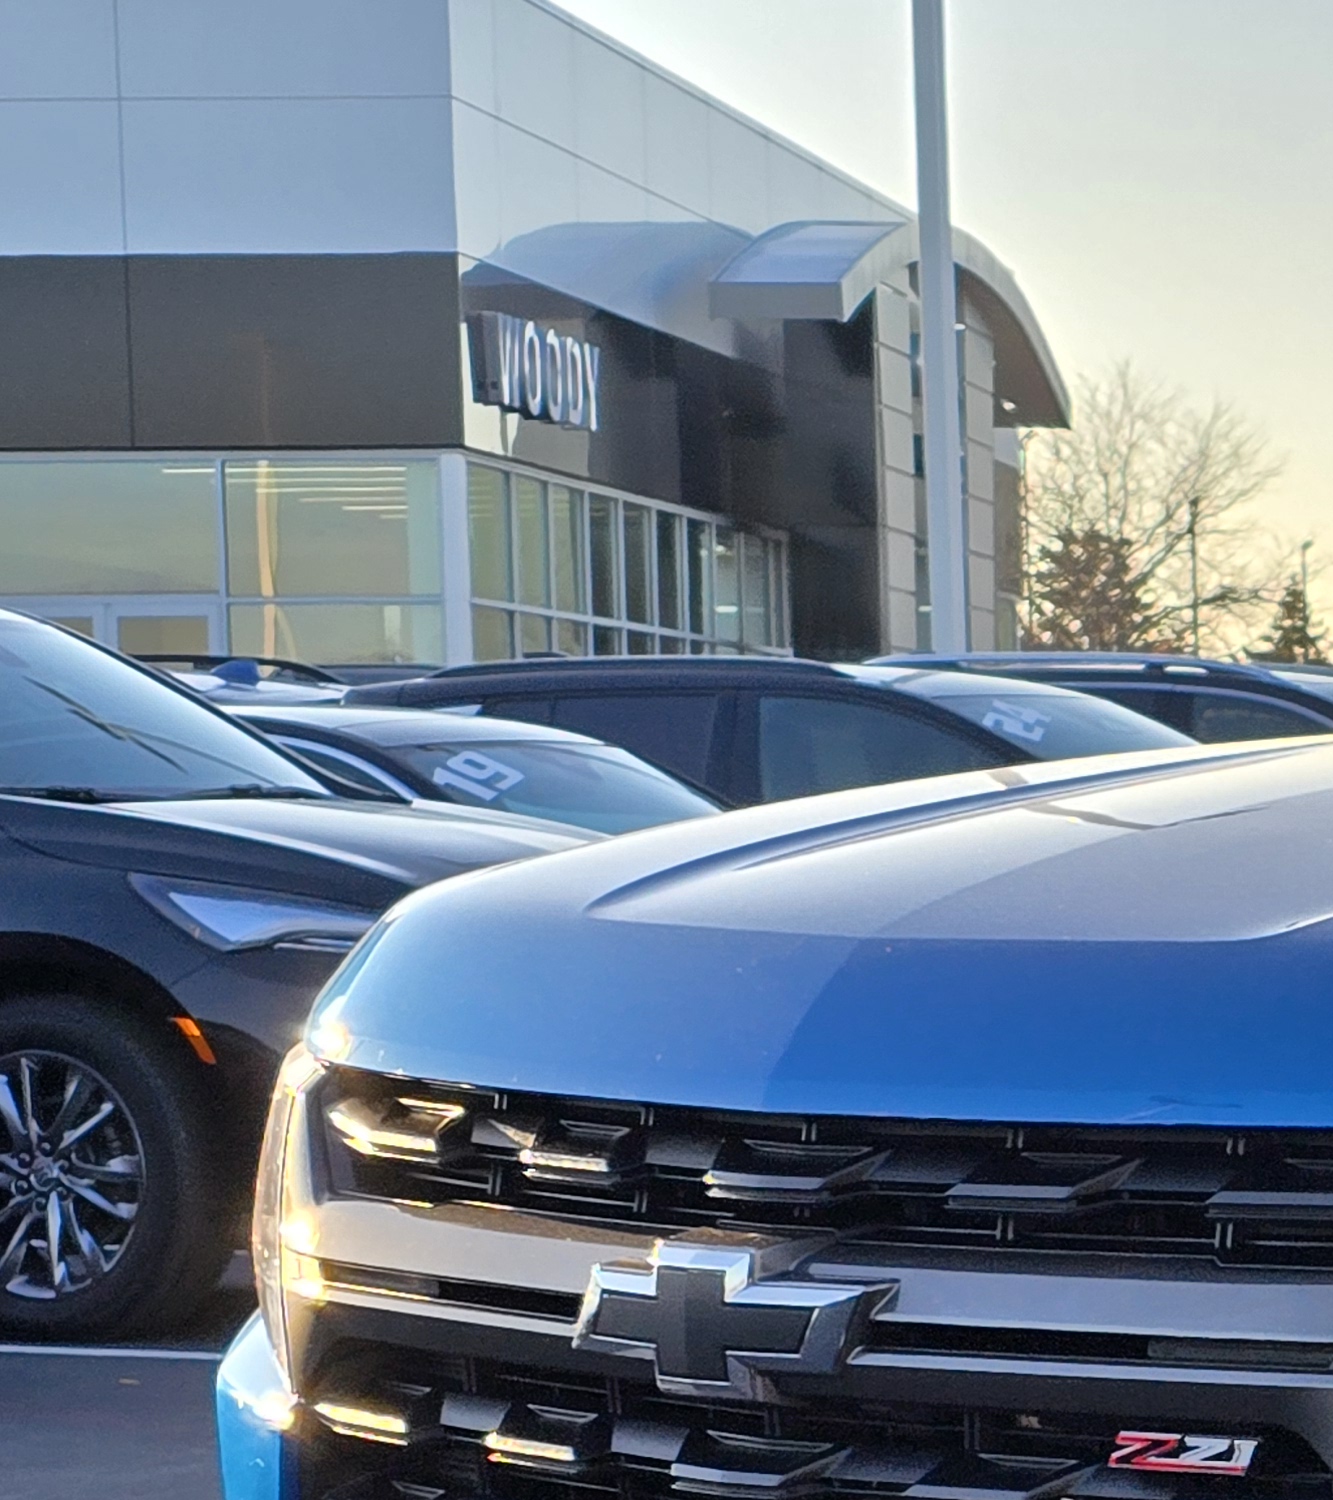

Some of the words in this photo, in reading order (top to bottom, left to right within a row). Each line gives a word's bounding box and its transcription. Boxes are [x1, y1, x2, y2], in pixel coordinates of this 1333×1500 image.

[497, 313, 601, 432] WOODY
[982, 699, 1052, 743] 24
[432, 750, 525, 800] 19
[1107, 1430, 1258, 1476] Z71
